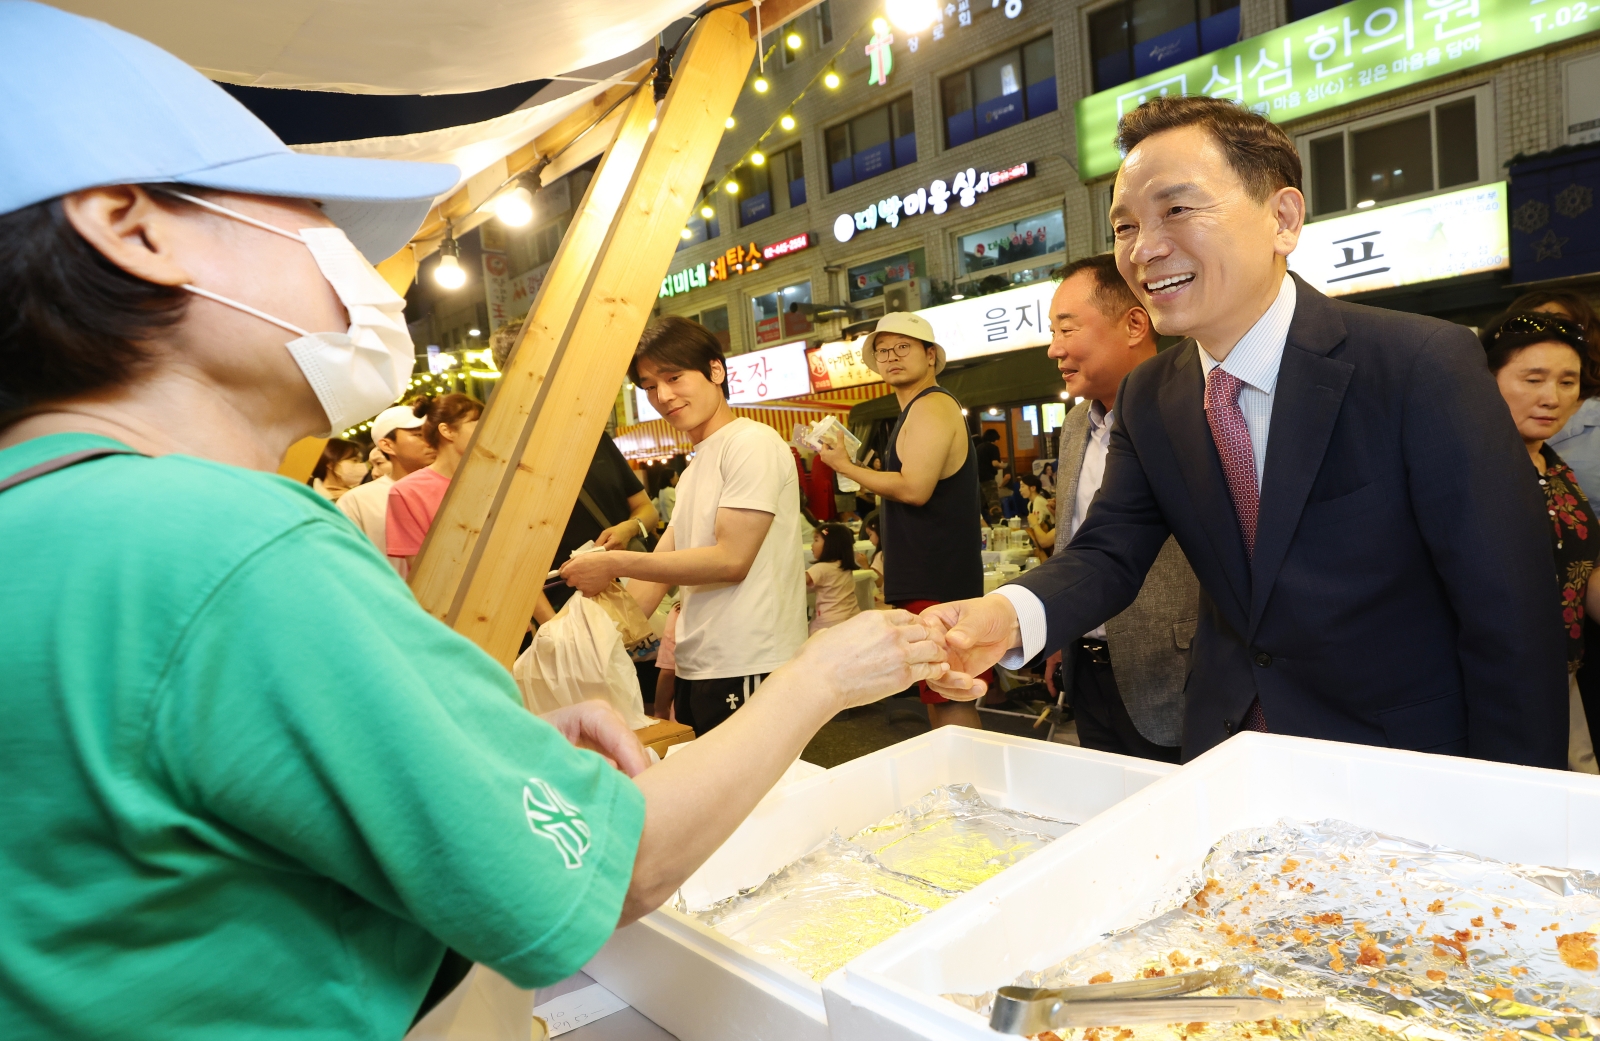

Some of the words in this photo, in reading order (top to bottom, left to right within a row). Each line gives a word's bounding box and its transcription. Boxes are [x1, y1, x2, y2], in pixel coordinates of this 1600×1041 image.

[1274, 91, 1301, 110] 마음
[1392, 47, 1441, 73] 마음을
[854, 167, 976, 230] 대박미용실
[708, 242, 763, 281] 세탁소
[1327, 231, 1391, 284] 프
[984, 299, 1052, 342] 을지
